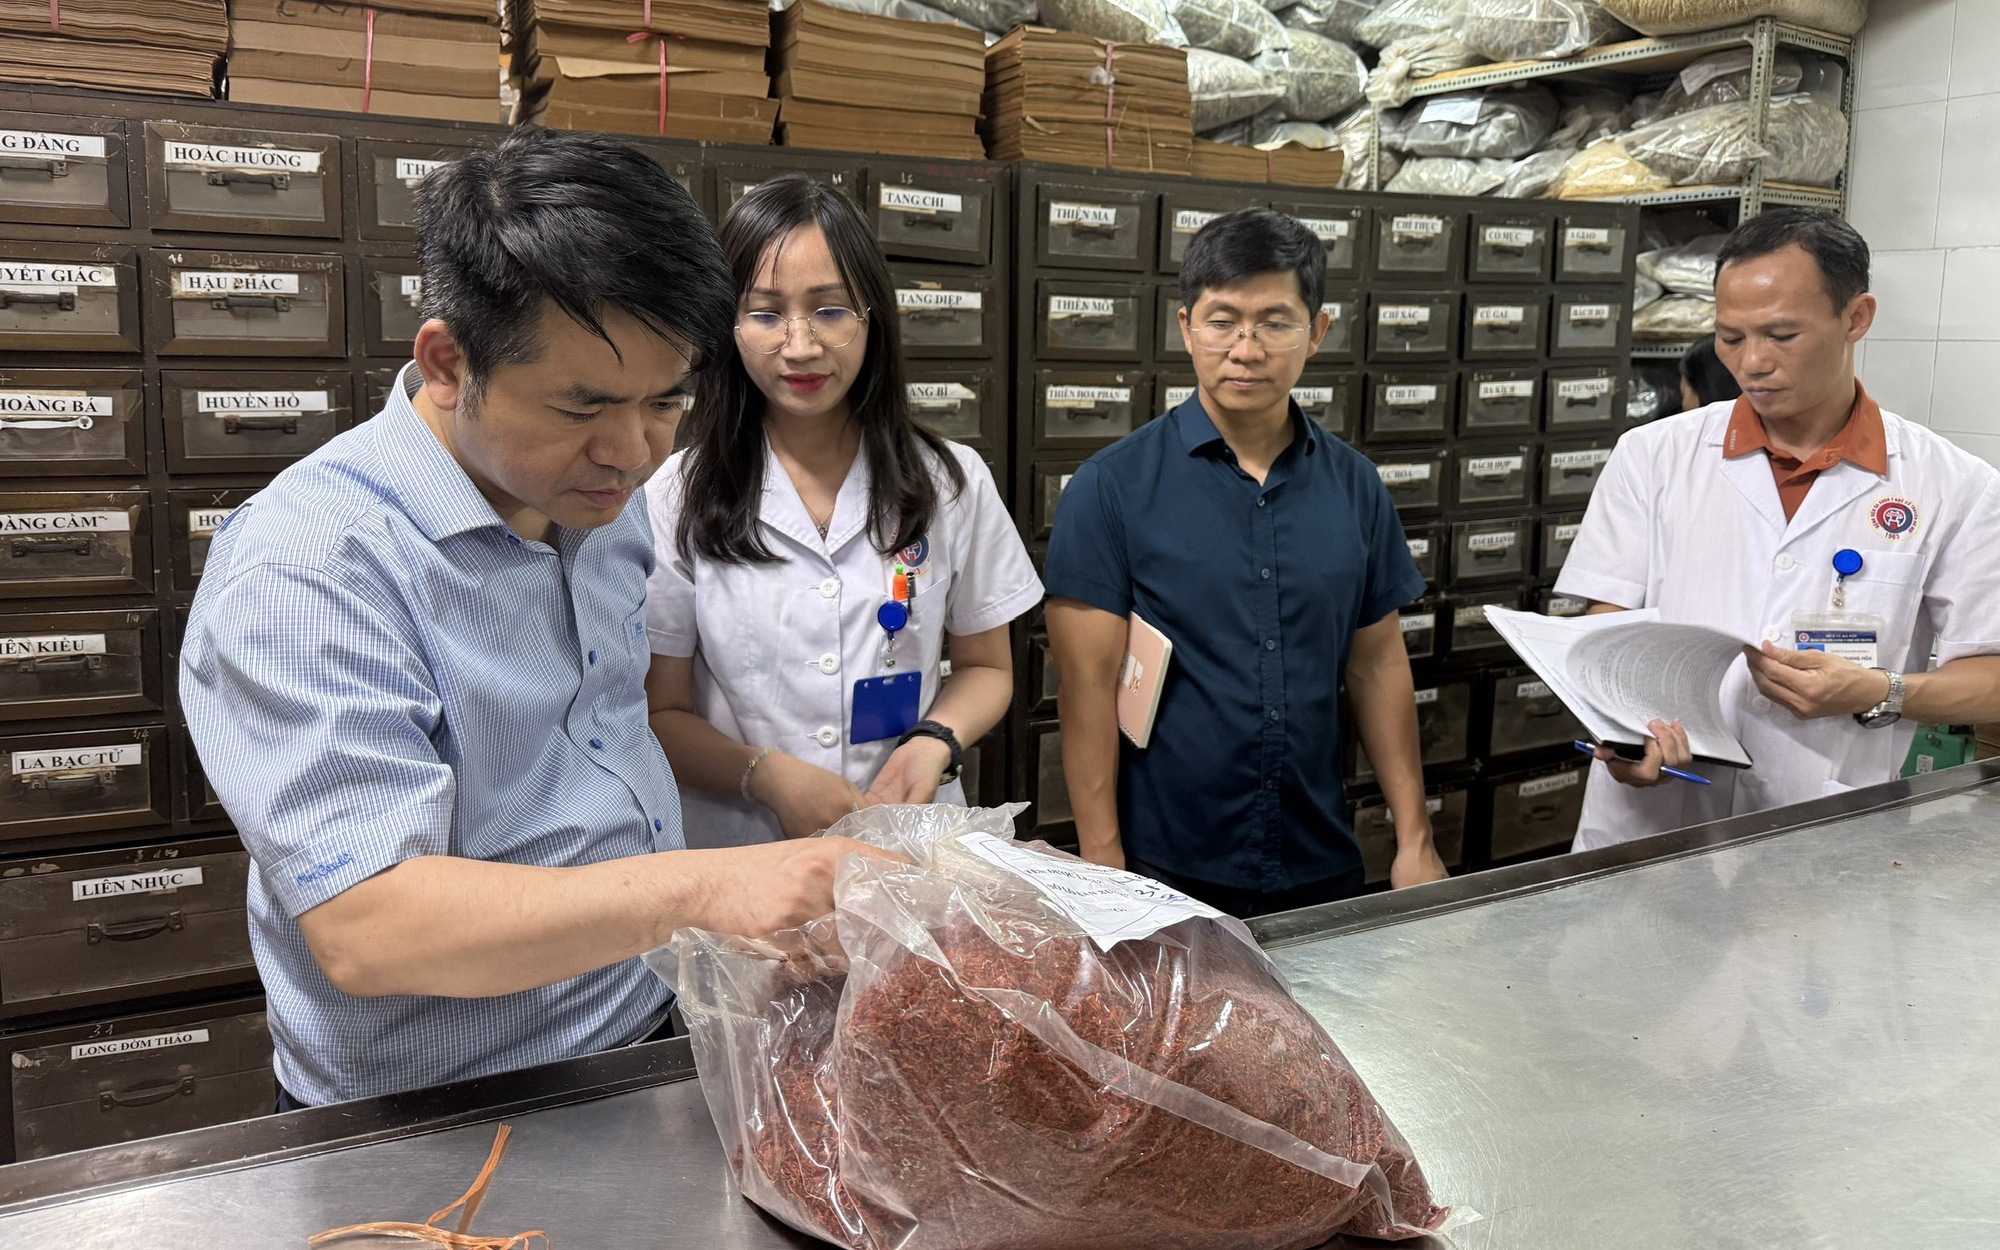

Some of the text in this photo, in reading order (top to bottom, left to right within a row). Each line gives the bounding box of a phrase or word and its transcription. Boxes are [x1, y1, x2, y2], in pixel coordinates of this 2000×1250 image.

[234, 150, 301, 167] HƯƠNG
[886, 192, 944, 208] TANG CHI
[1093, 210, 1109, 221] MA
[51, 266, 102, 282] GIÁC
[188, 275, 283, 292] HẬU PHÁC
[900, 293, 932, 305] TANG
[909, 386, 933, 397] ANG
[72, 397, 98, 412] BÁ
[0, 514, 47, 531] ÀNG
[20, 748, 124, 770] LA BẠC TỬ
[82, 873, 184, 897] LIÊN NHỤC
[79, 1044, 117, 1057] LONG
[154, 1033, 193, 1046] THẢO
